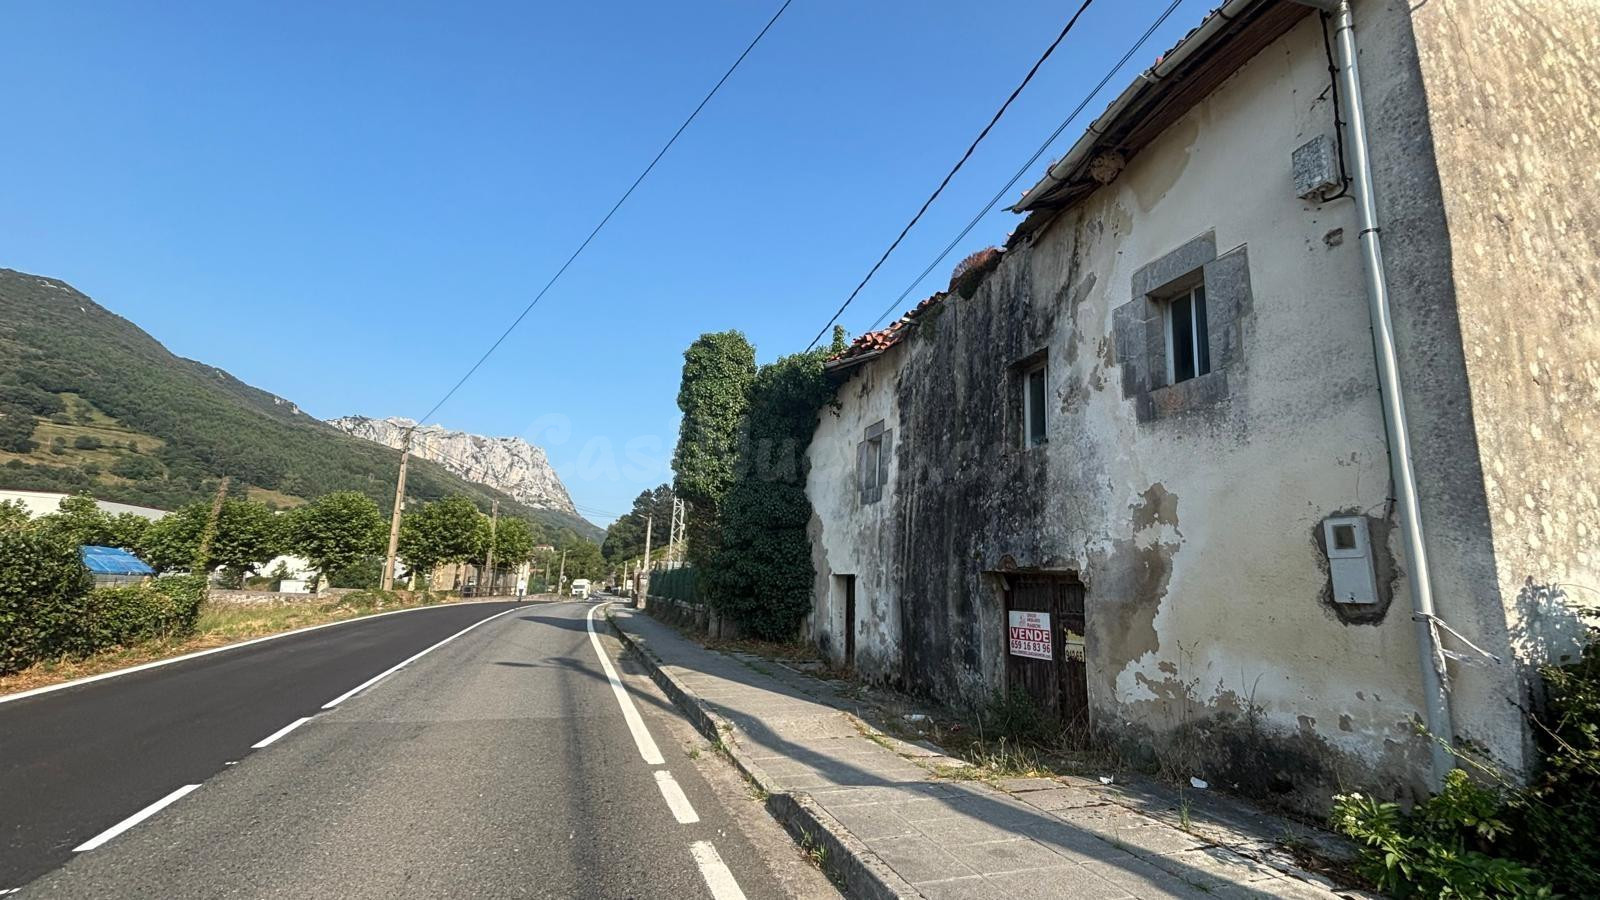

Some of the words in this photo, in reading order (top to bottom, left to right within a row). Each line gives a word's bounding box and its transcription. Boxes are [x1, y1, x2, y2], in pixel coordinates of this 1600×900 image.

[1011, 628, 1050, 643] VENDE
[1011, 640, 1022, 649] 659
[1024, 641, 1031, 651] 16
[1033, 642, 1041, 652] 83
[1042, 643, 1051, 654] 96
